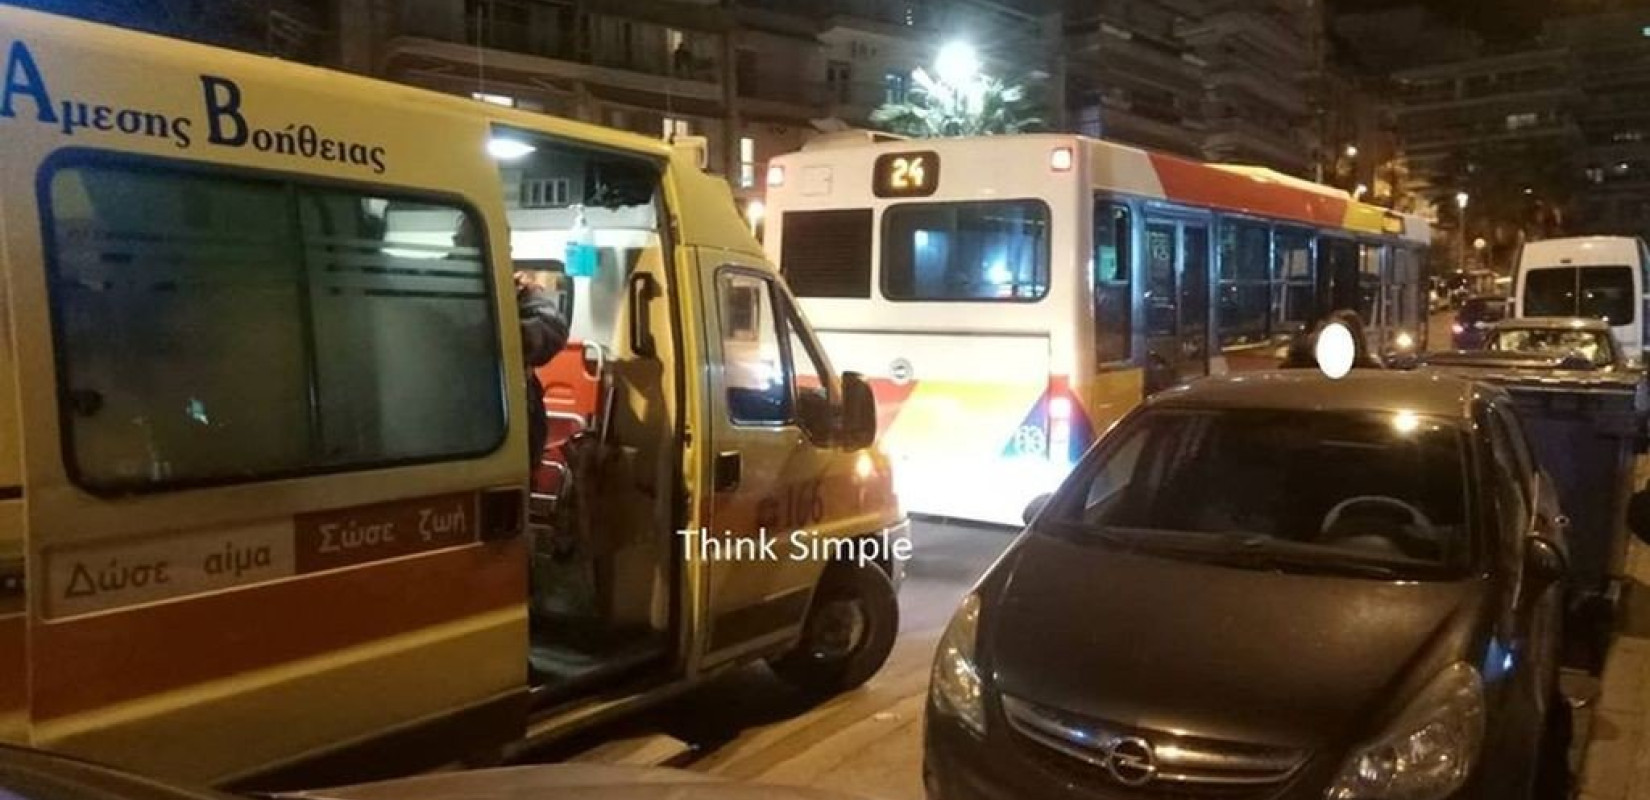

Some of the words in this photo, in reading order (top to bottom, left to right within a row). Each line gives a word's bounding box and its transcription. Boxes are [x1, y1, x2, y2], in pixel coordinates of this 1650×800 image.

[200, 75, 386, 173] Βοήθειας
[891, 157, 924, 188] 24
[318, 519, 395, 553] Σώσε
[418, 503, 467, 541] ζωή
[65, 557, 169, 598] Δώσε
[204, 541, 271, 577] αίμα
